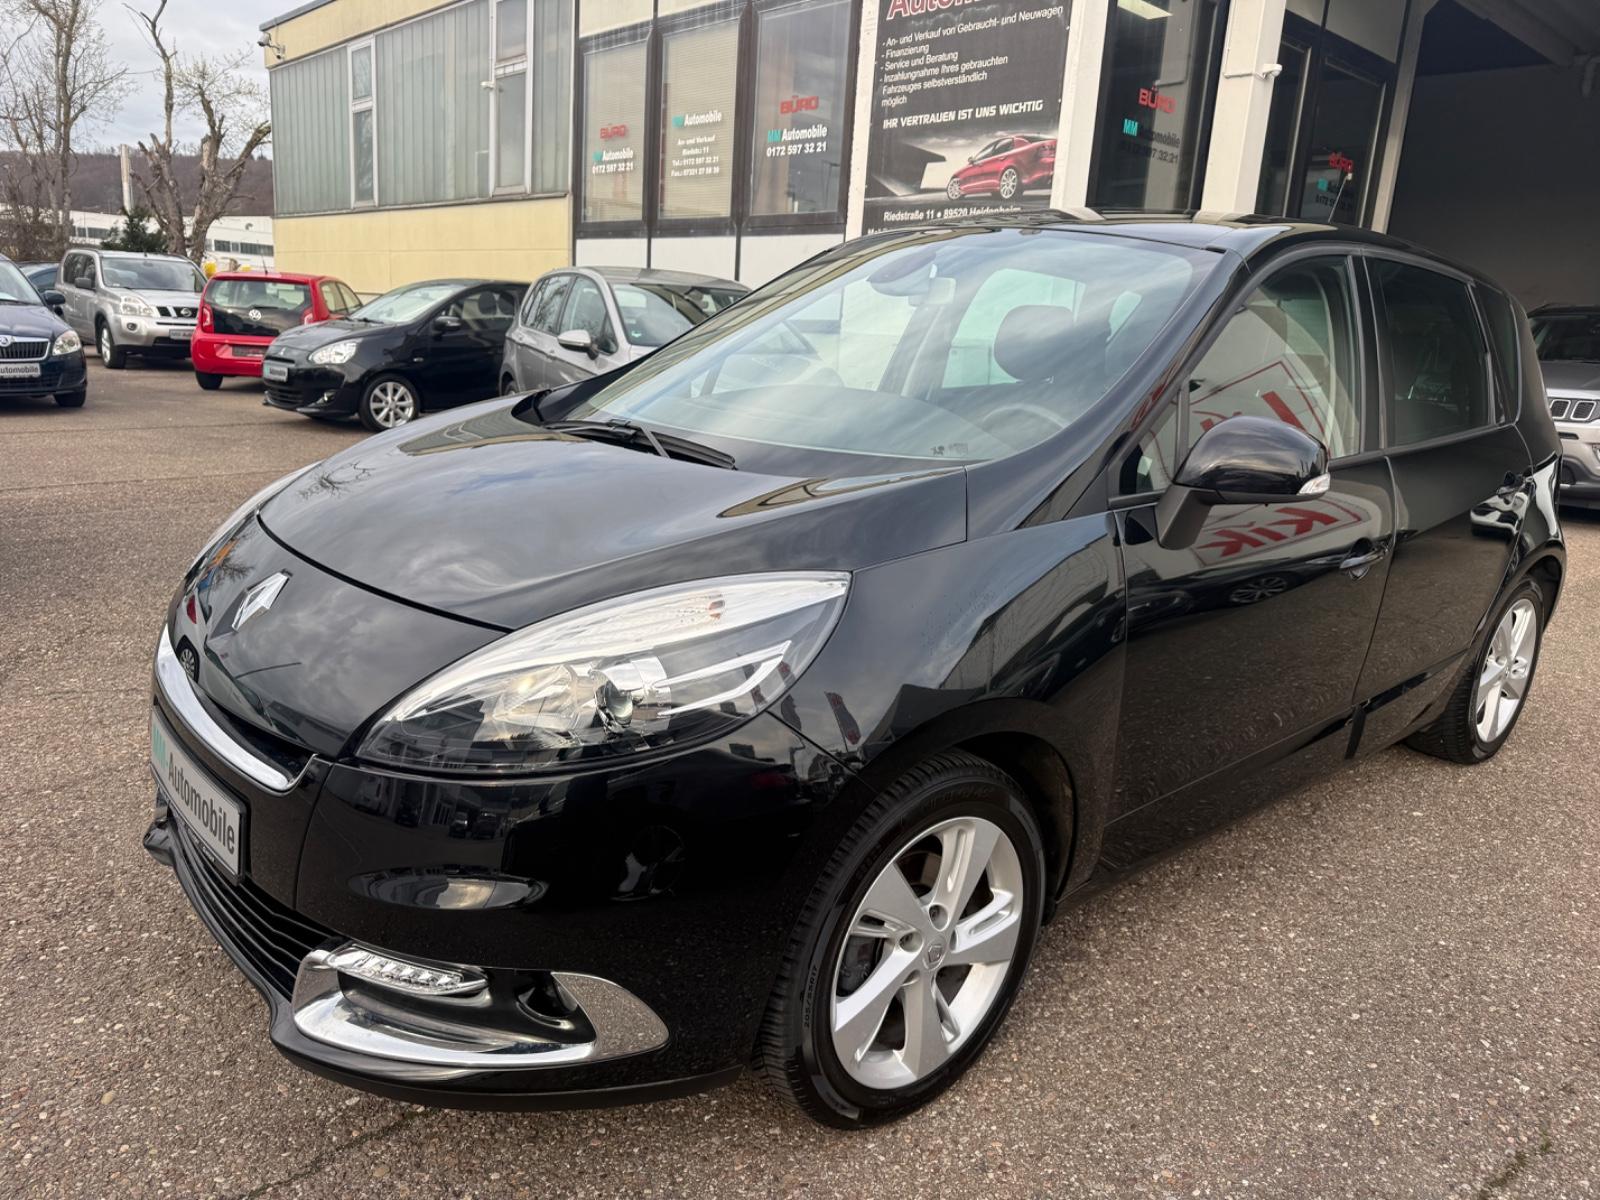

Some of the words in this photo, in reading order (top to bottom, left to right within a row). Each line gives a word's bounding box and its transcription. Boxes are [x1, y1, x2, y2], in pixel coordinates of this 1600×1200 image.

[886, 37, 898, 47] An-
[900, 34, 912, 44] und
[914, 28, 941, 41] Verkauf
[942, 27, 956, 36] von
[957, 17, 999, 33] Gebraucht-
[1001, 13, 1017, 26] und
[1019, 6, 1063, 22] Neuwagen
[885, 44, 929, 58] Finanzierung
[883, 67, 940, 82] Inzahlungnahme
[940, 64, 959, 74] Ihres
[960, 56, 1008, 73] gebrauchten
[885, 59, 909, 71] Service
[911, 55, 925, 67] und
[926, 51, 959, 64] Beratung
[882, 82, 922, 95] Fahrzeuges
[923, 70, 987, 89] selbstverständlich
[780, 95, 819, 114] BÜRO
[881, 94, 908, 108] möglich
[684, 110, 722, 127] Automobile
[883, 118, 899, 130] IHR
[900, 110, 957, 127] VERTRAUEN
[958, 108, 974, 120] IST
[975, 105, 997, 118] UNS
[999, 99, 1043, 115] WICHTIG
[781, 123, 828, 142] Automobile
[1122, 118, 1138, 136] MM
[603, 146, 634, 161] Automobile
[766, 146, 786, 157] 0172
[787, 144, 802, 155] 597
[804, 142, 815, 153] 32
[816, 141, 827, 152] 21
[883, 206, 924, 222] Riedstraße
[925, 208, 934, 219] 11
[943, 207, 968, 219] 89520
[168, 752, 235, 856] Automobile
